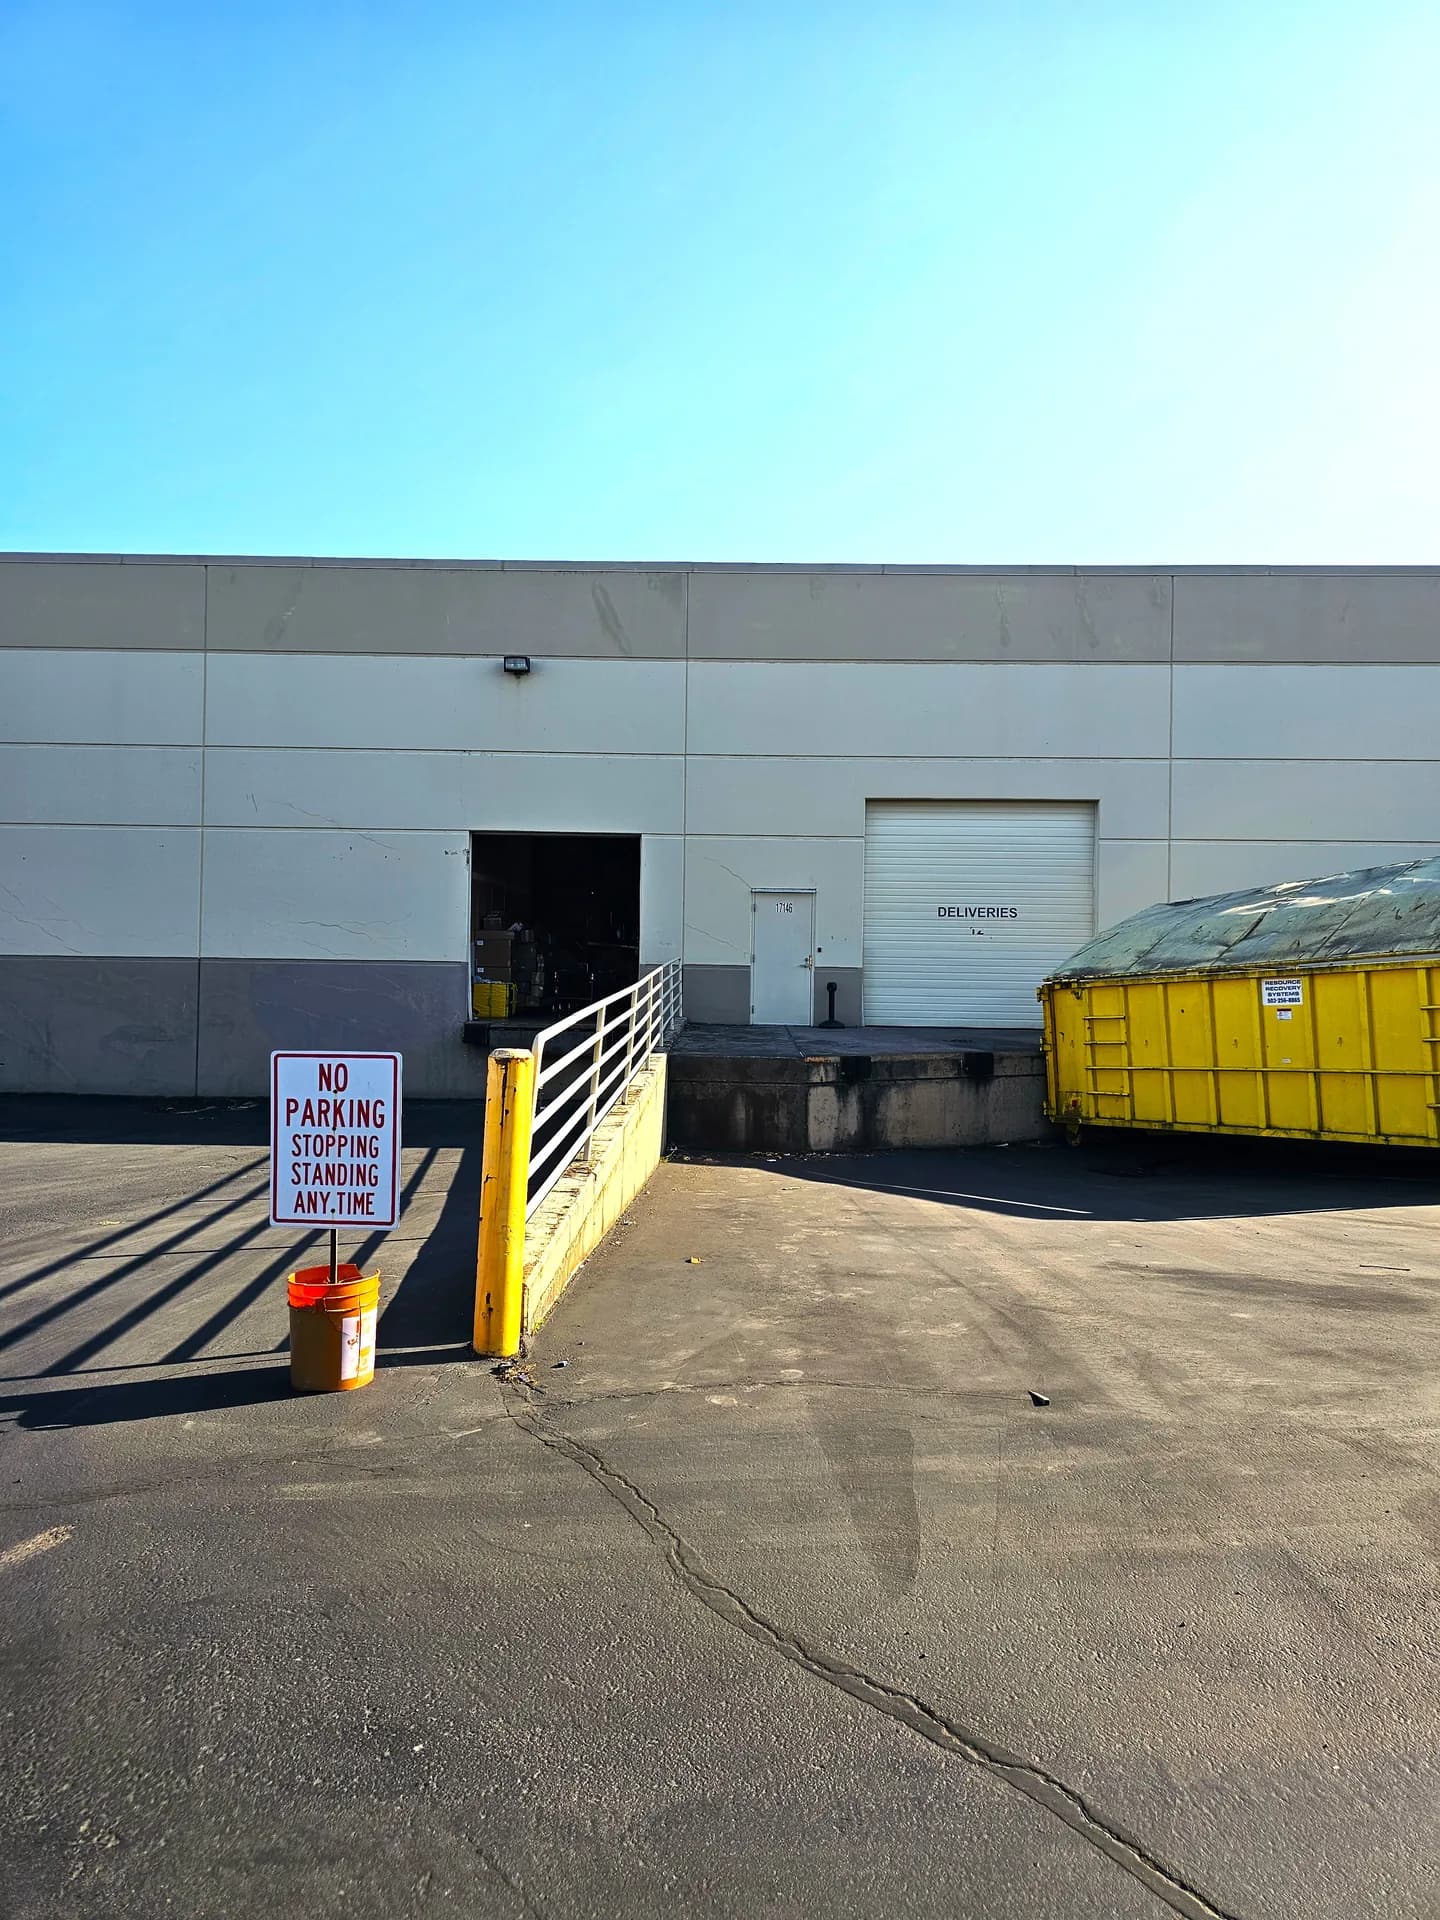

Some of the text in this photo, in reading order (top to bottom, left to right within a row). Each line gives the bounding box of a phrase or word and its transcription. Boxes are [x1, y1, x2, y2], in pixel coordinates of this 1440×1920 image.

[776, 902, 792, 913] 17146
[938, 906, 1018, 918] DELIVERIES
[318, 1063, 349, 1093] NO
[285, 1098, 385, 1129] PARKING
[291, 1133, 379, 1159] STOPPING
[290, 1162, 379, 1187] STANDING
[293, 1191, 375, 1215] ANY TIME
